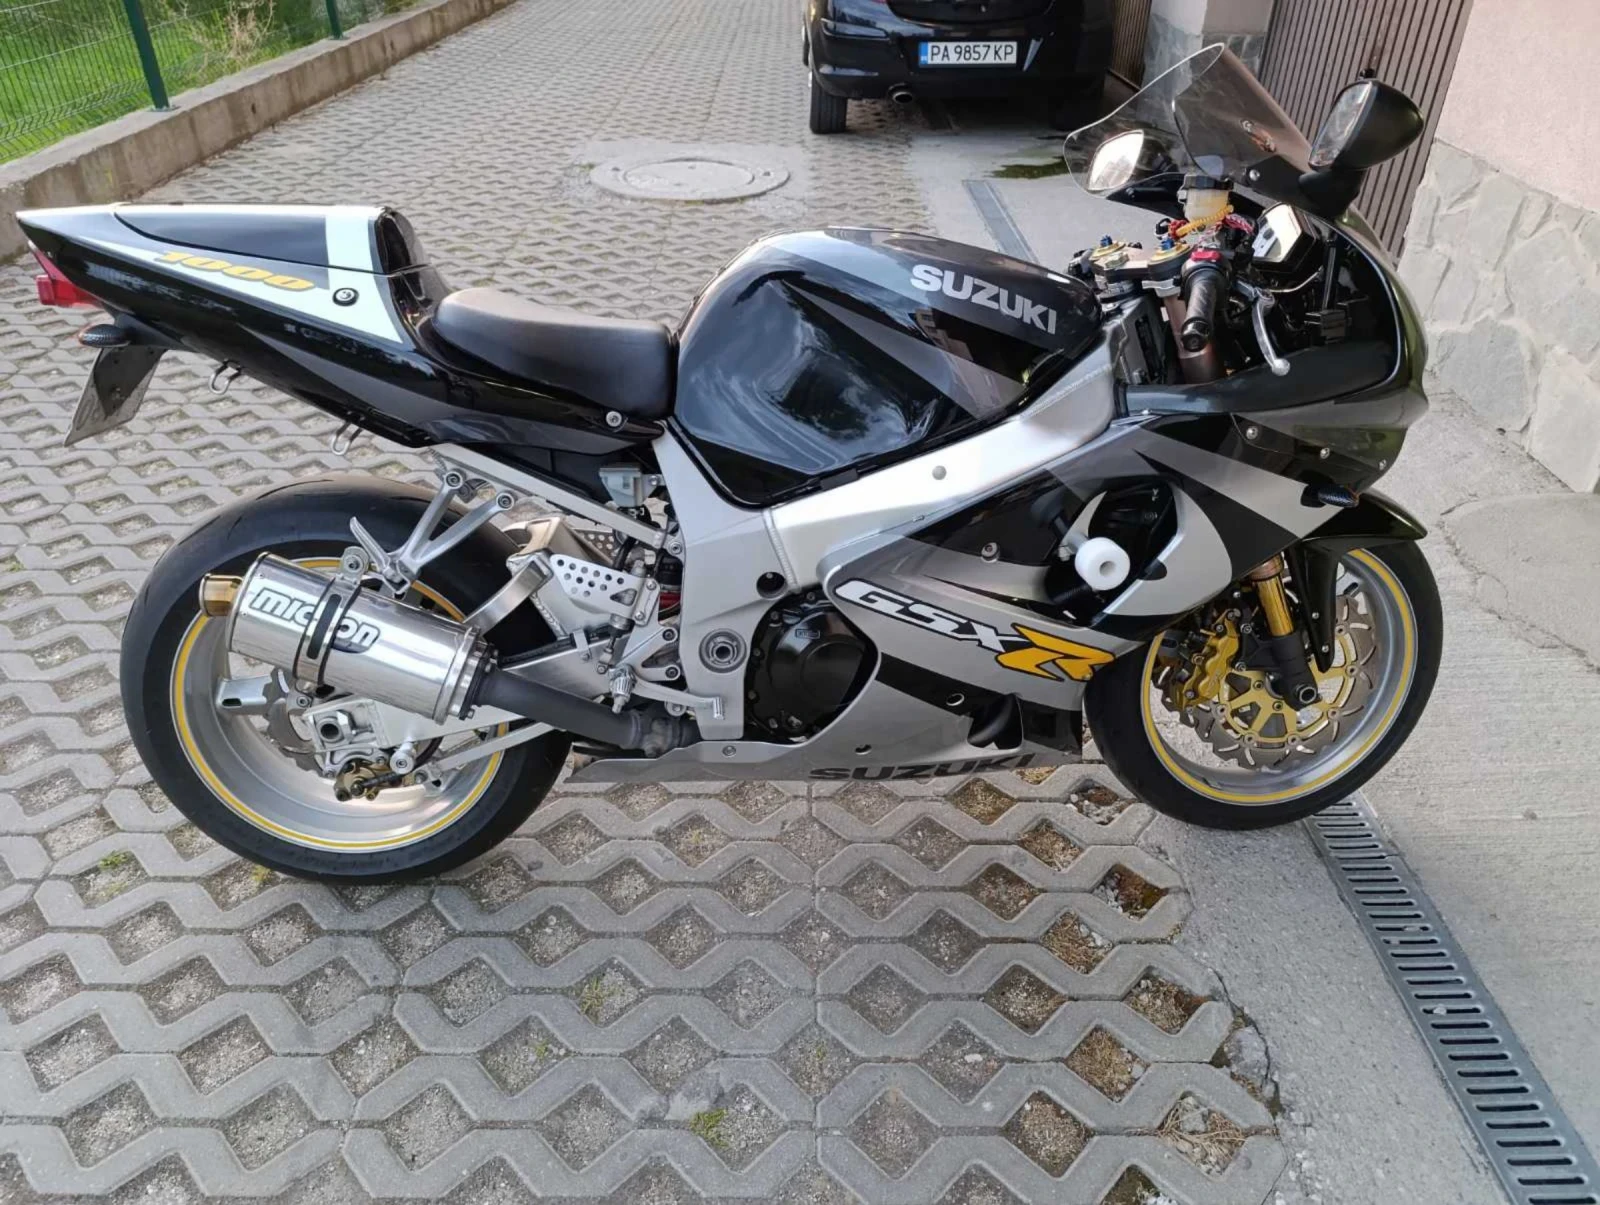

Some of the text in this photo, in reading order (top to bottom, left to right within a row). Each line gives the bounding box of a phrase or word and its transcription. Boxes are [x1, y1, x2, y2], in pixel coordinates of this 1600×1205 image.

[931, 44, 1014, 61] PA 9857 KP
[155, 251, 316, 292] 1000
[910, 264, 1057, 335] SUZUKI
[249, 587, 381, 653] micon
[808, 753, 1036, 781] SUZUKI
